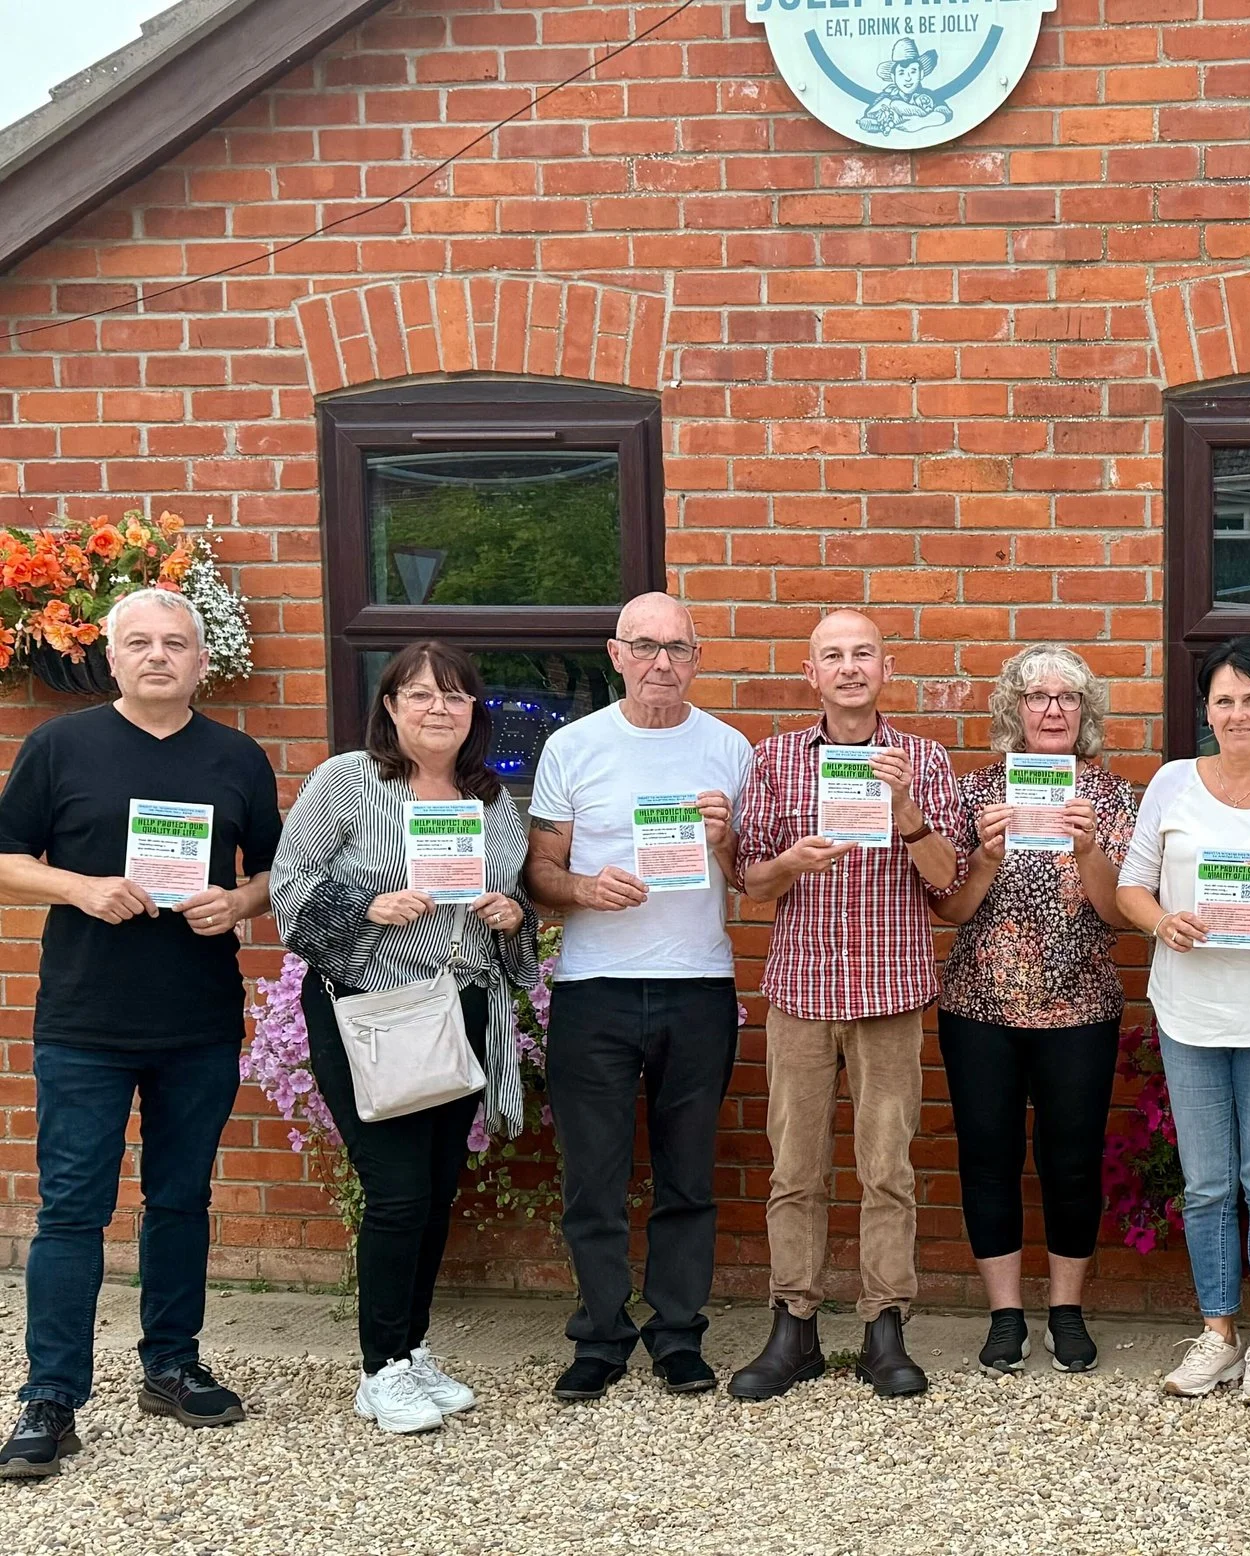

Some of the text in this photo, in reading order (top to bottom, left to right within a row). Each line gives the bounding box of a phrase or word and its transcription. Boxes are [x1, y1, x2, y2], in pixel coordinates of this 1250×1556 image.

[826, 13, 979, 38] EAT, DRINK & BE JOLLY
[644, 816, 668, 824] QUALITY
[158, 820, 187, 828] PROTECT
[189, 822, 203, 830] OUR
[420, 827, 445, 835] QUALITY
